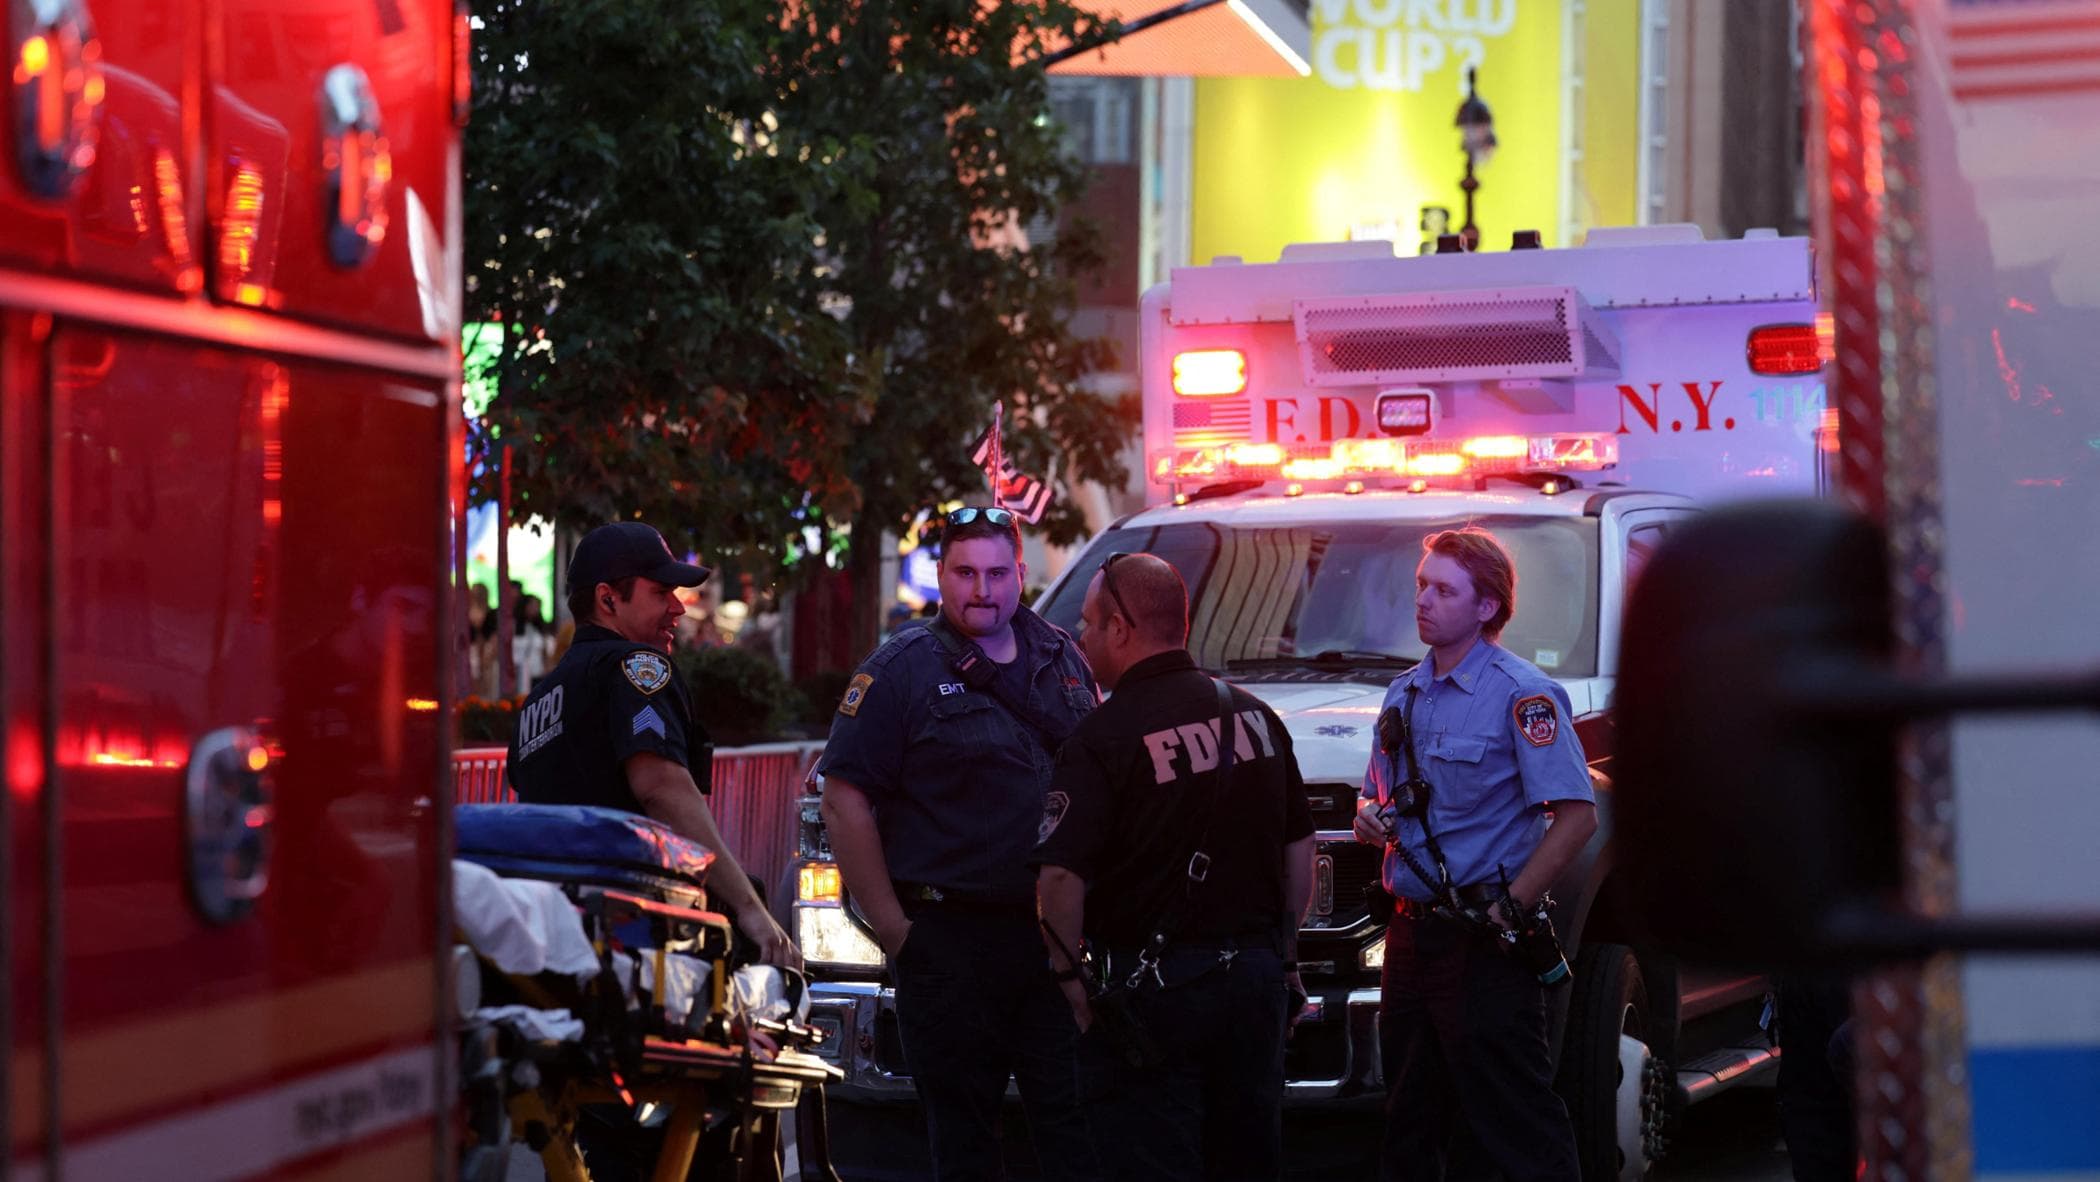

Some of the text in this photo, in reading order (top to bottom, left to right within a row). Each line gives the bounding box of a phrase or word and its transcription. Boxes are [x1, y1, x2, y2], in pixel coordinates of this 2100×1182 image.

[1616, 381, 1735, 434] N.Y.
[519, 684, 563, 748] NYPD
[938, 683, 966, 695] EMT
[1142, 709, 1276, 785] FDNY
